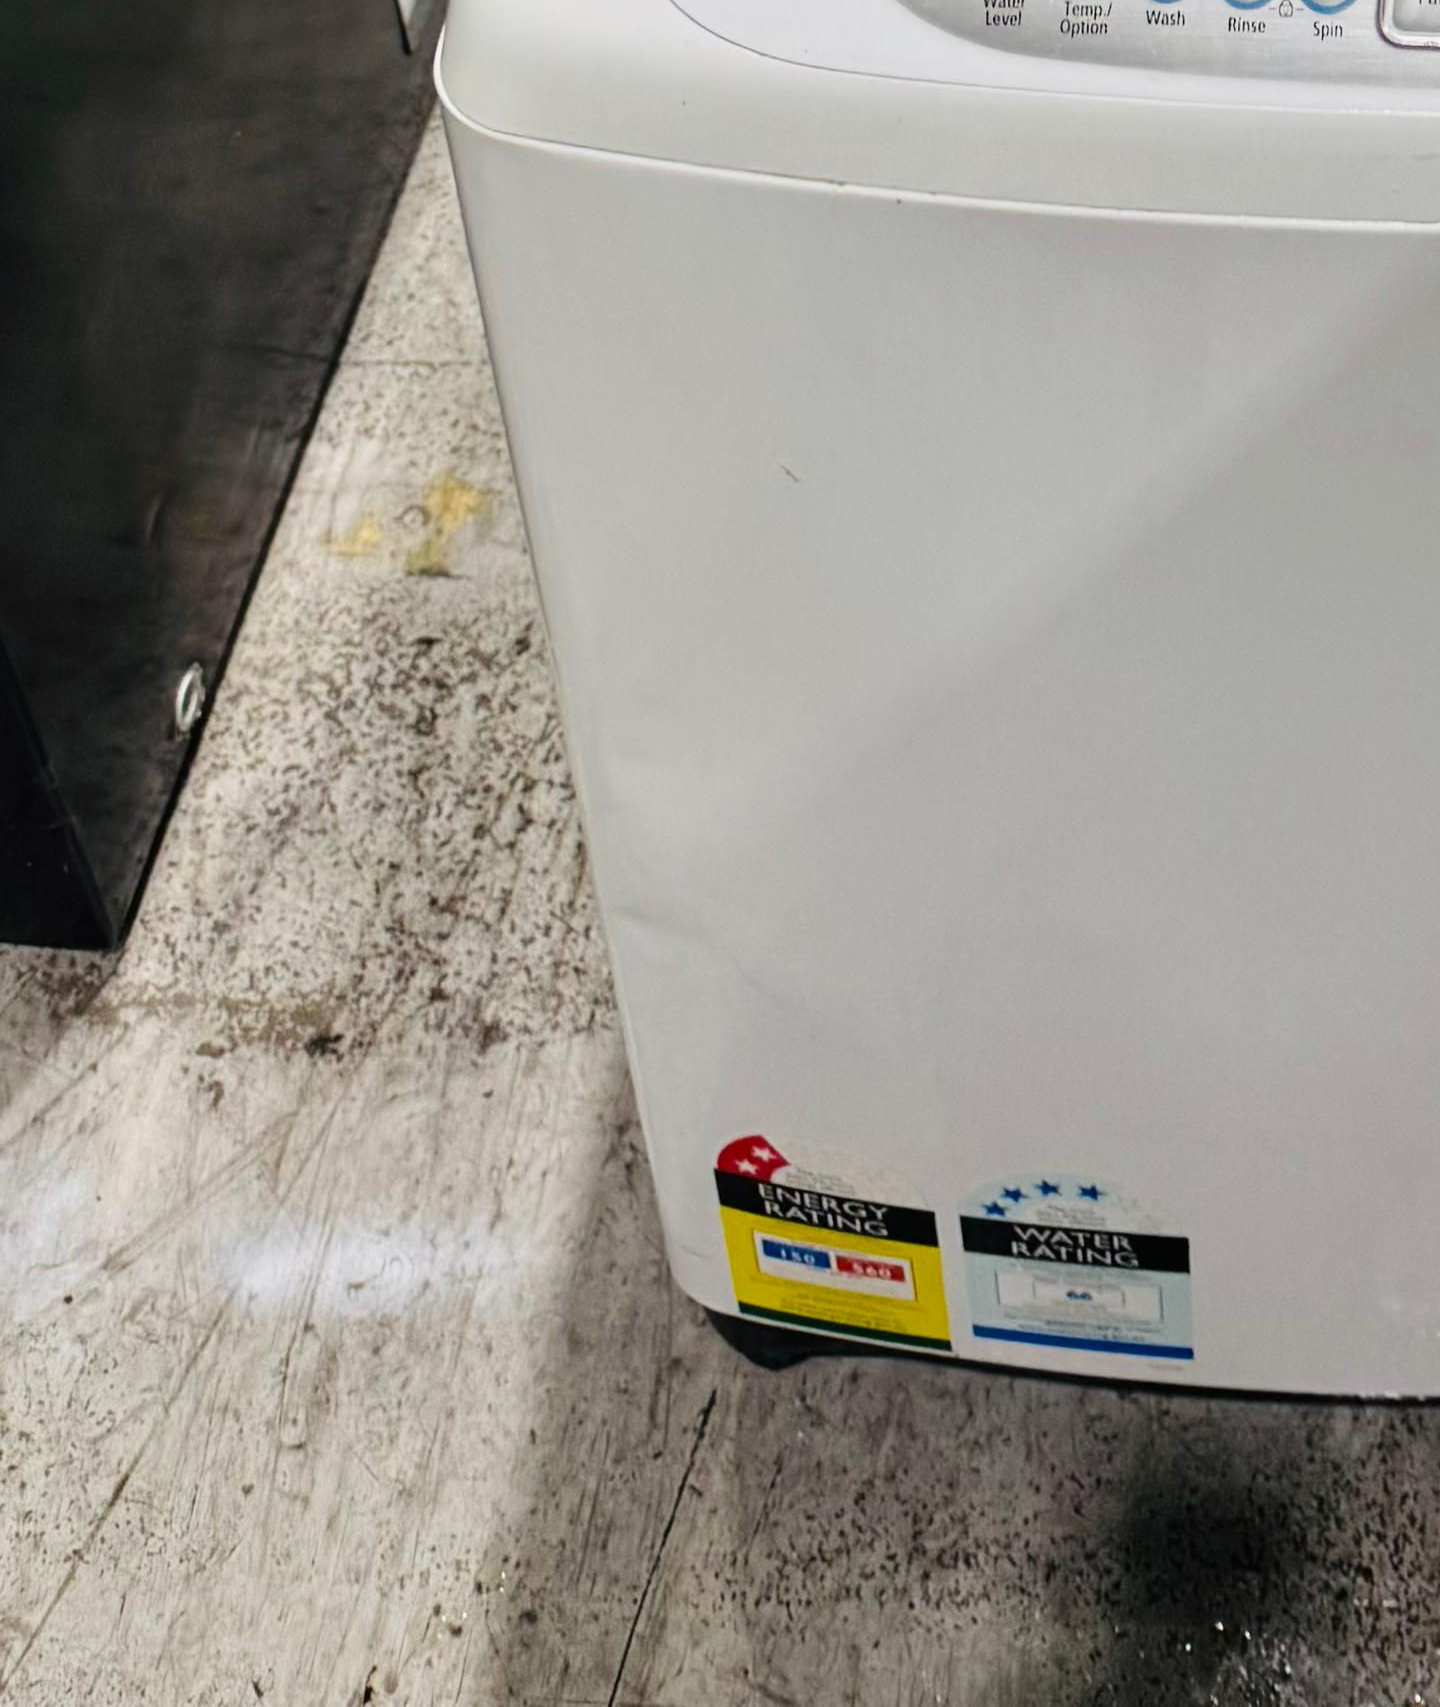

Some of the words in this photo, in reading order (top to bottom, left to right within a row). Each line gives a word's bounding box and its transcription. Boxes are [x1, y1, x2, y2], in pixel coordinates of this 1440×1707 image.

[985, 10, 1022, 27] Level
[1059, 19, 1109, 38] Option
[1145, 10, 1186, 26] Wash
[1227, 16, 1267, 34] Rinse
[1312, 20, 1344, 41] Spin
[758, 1183, 890, 1221] ENERGY
[764, 1200, 890, 1237] RATING
[1013, 1225, 1133, 1252] WATER
[1010, 1240, 1140, 1269] RATING
